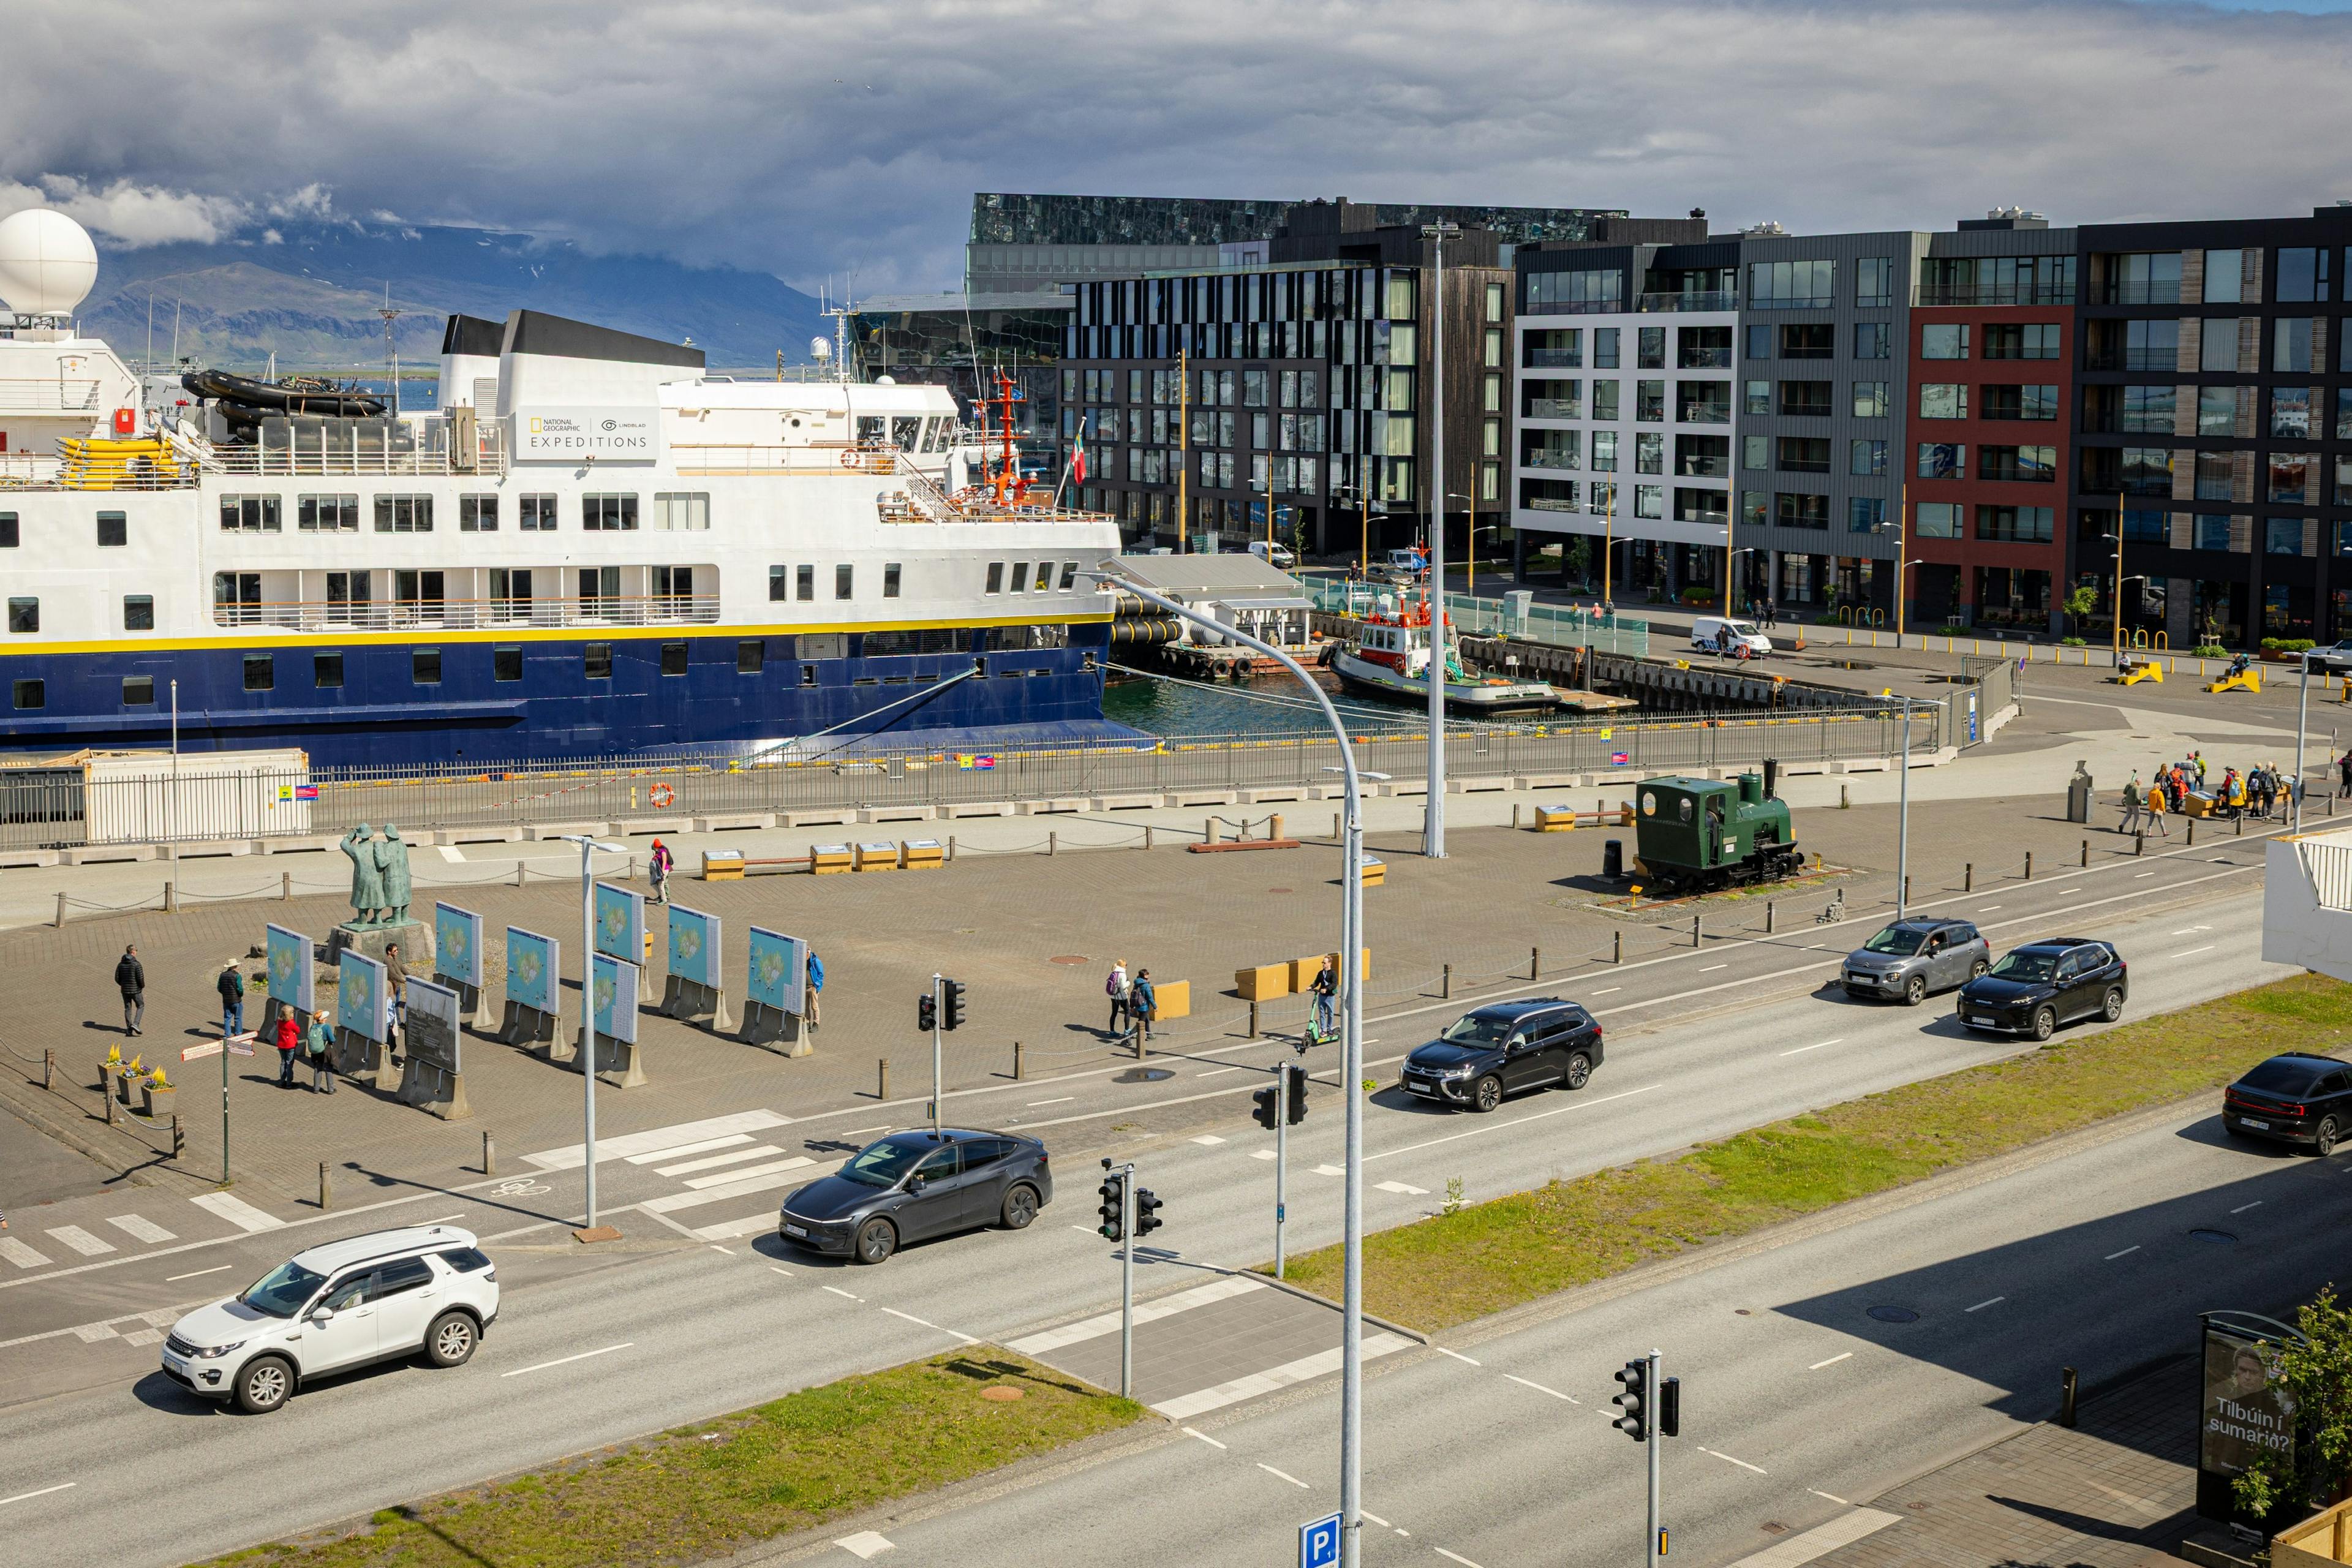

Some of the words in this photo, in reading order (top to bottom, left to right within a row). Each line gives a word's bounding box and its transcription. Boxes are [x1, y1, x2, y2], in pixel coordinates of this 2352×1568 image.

[530, 437, 646, 448] EXPEDITIONS
[2216, 1396, 2273, 1428] Tilbúin
[2277, 1415, 2283, 1431] í
[2209, 1418, 2290, 1452] sumarið?
[1314, 1531, 1330, 1561] P
[1327, 1550, 1331, 1559] 1
